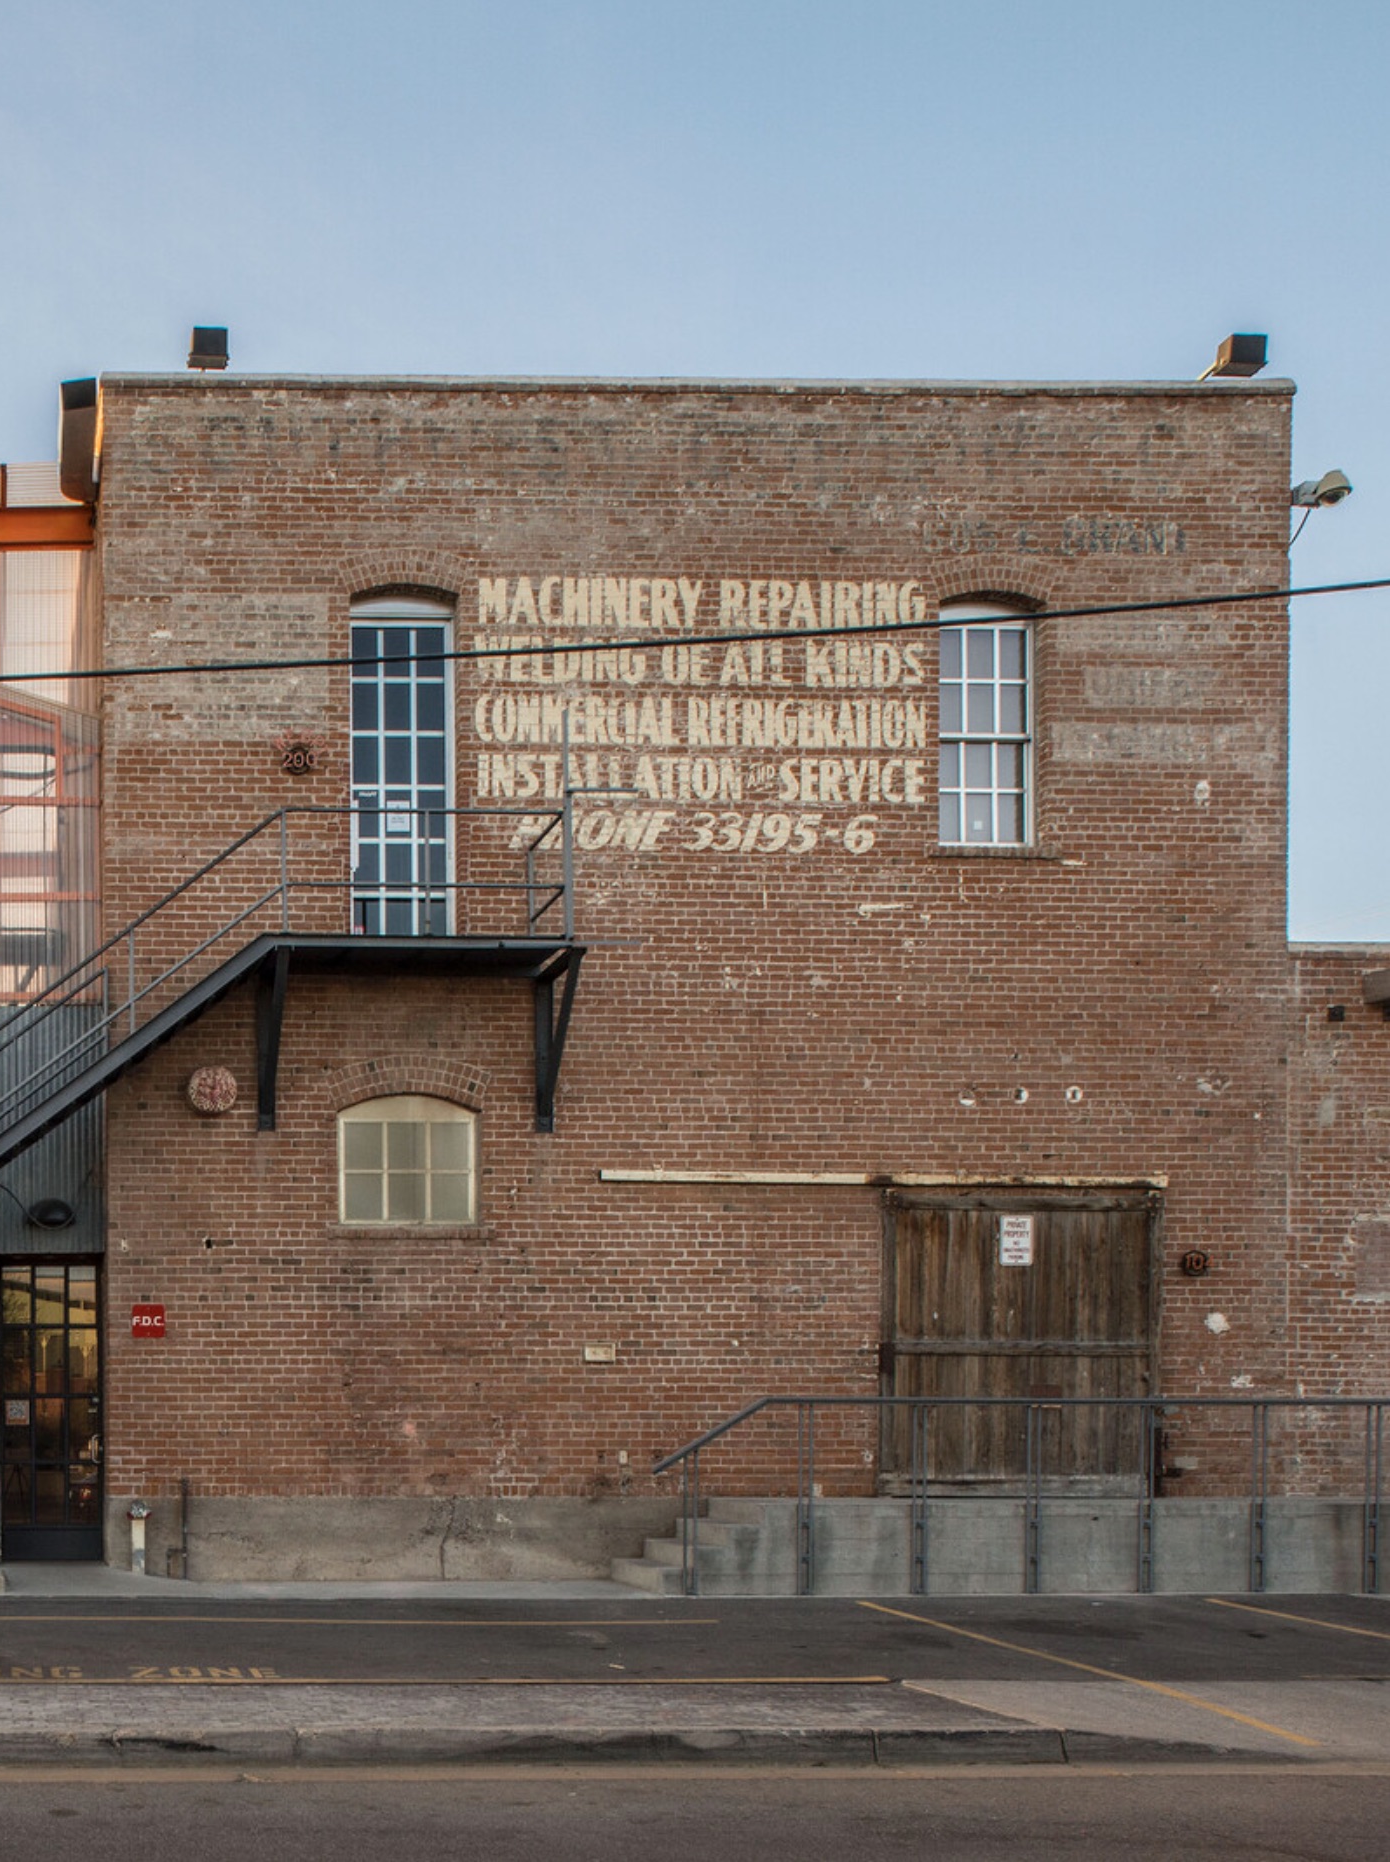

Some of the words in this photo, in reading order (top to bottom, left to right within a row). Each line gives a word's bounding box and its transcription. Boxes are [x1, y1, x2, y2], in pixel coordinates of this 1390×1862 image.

[478, 576, 702, 629] MACHINERY
[719, 580, 926, 630] REPAIRING
[474, 634, 646, 685] WELDING
[719, 637, 793, 687] ALL
[806, 639, 926, 688] KINDS
[474, 694, 680, 745] COMMERCIAL
[687, 696, 927, 748] REFRIGERATION
[282, 751, 318, 768] 200
[476, 753, 742, 801] INSTALLATION
[746, 762, 776, 792] AND
[778, 757, 926, 803] SERVICE
[679, 811, 879, 855] 33195-6
[132, 1315, 165, 1327] F.D.C.
[127, 1666, 283, 1680] ZONE
